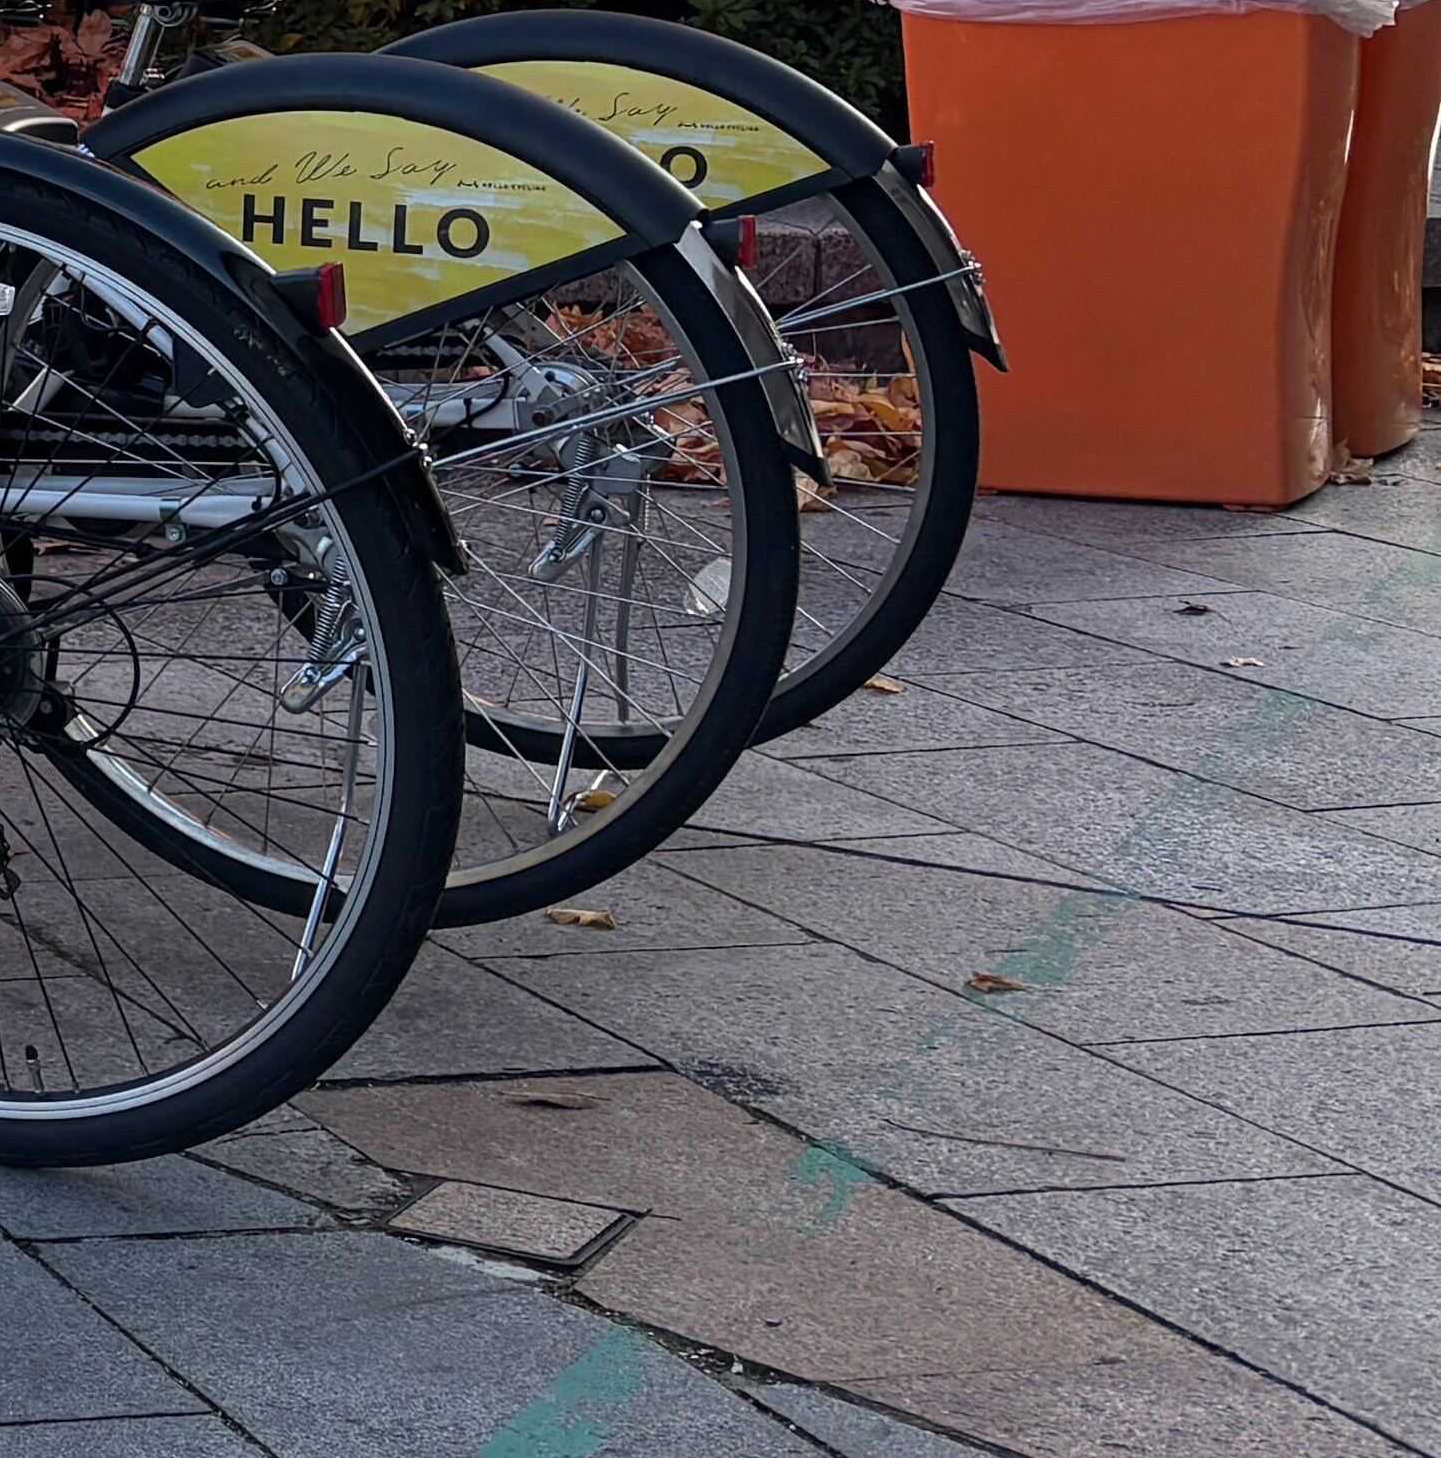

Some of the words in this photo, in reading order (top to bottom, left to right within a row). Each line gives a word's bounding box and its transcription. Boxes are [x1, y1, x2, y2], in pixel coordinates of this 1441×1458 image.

[598, 92, 678, 125] Say
[206, 164, 278, 190] and
[295, 150, 357, 184] We
[370, 147, 456, 185] Say
[242, 193, 490, 259] HELLO
